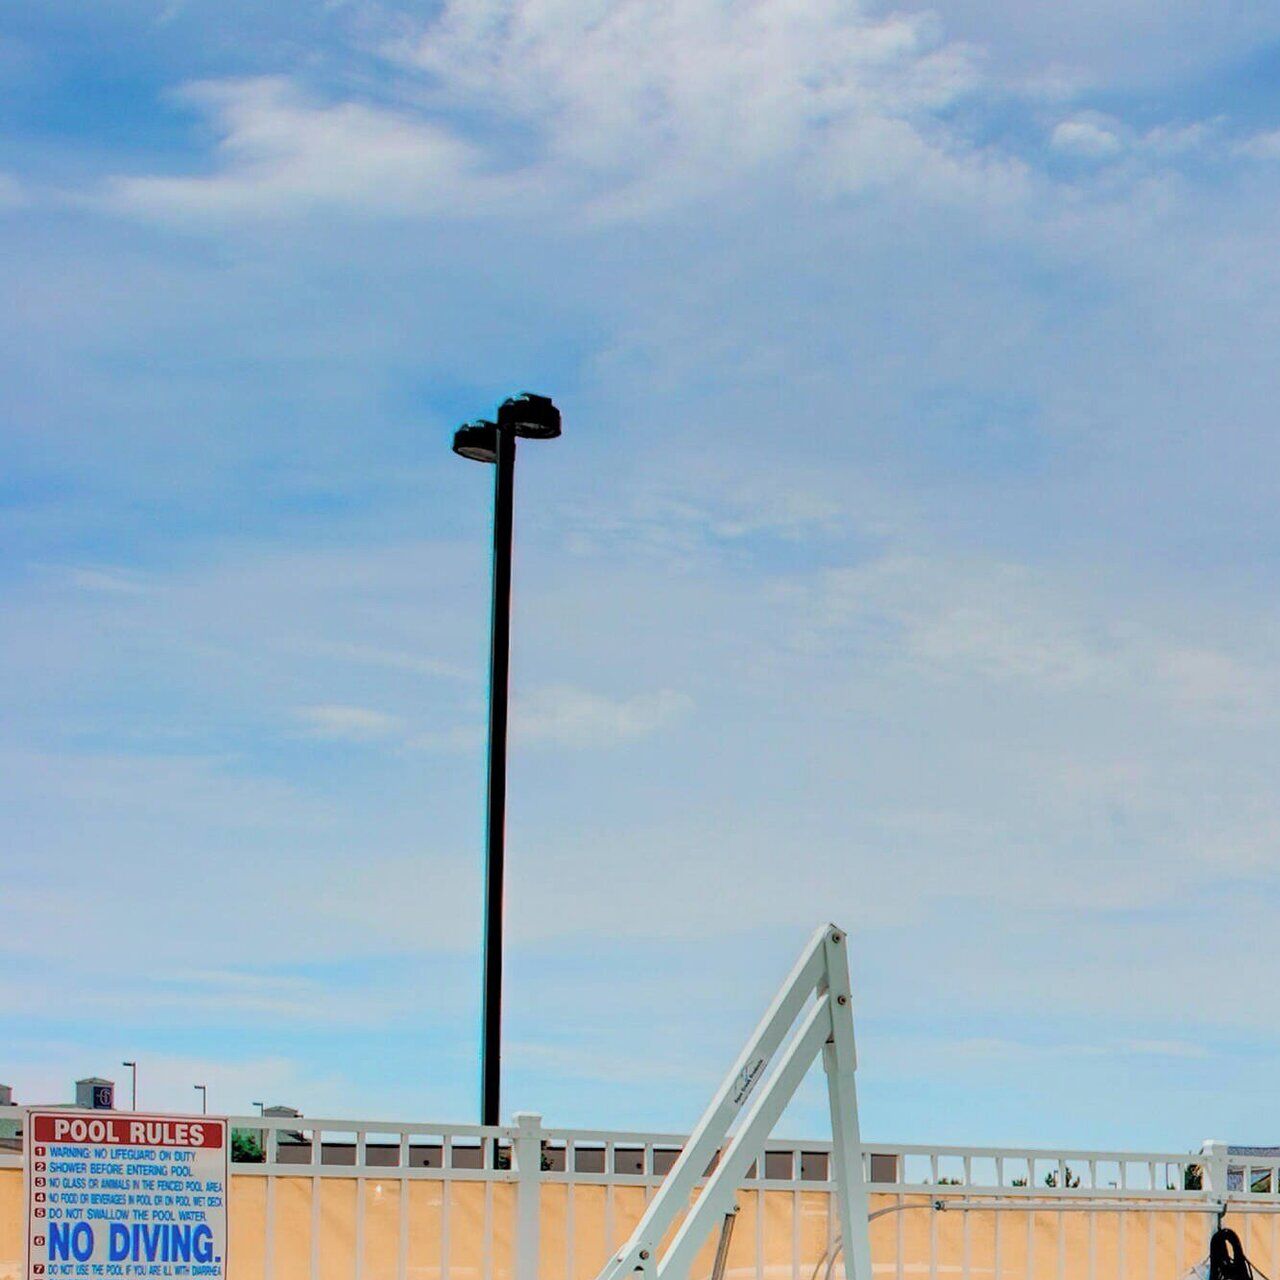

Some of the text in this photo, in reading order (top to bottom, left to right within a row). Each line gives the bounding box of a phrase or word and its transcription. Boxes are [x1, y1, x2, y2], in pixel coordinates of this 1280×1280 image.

[54, 1119, 204, 1146] POOL RULES
[94, 1148, 107, 1158] NO
[110, 1149, 156, 1160] LIFEGUARD
[160, 1150, 171, 1160] ON
[174, 1151, 196, 1161] DUTY
[49, 1162, 87, 1173] SHOWER
[90, 1163, 123, 1174] BEFORE
[127, 1164, 167, 1175] ENTERING
[171, 1166, 193, 1176] POOL
[49, 1177, 60, 1188] NO
[62, 1178, 86, 1188] GLASS
[88, 1179, 98, 1188] OR
[101, 1179, 130, 1190] ANIMALS
[133, 1180, 139, 1189] IN
[142, 1180, 154, 1190] THE
[157, 1180, 183, 1191] FENCED
[186, 1181, 203, 1192] POOL
[206, 1181, 223, 1192] AREA
[49, 1193, 59, 1203] NO
[61, 1193, 78, 1204] FOOD
[80, 1194, 89, 1203] OR
[91, 1194, 126, 1204] BEVERAGES
[136, 1195, 152, 1205] POOL
[193, 1196, 205, 1206] WET
[49, 1208, 62, 1218] DO
[66, 1208, 83, 1218] NOT
[87, 1208, 129, 1219] SWALLOW
[133, 1209, 148, 1219] THE
[152, 1210, 175, 1220] POOL
[179, 1210, 206, 1221] WATER
[48, 1221, 94, 1262] NO
[109, 1222, 222, 1263] DIVING.
[48, 1264, 58, 1275] DO
[60, 1264, 73, 1275] NOT
[76, 1265, 89, 1275] USE
[92, 1265, 103, 1275] THE
[106, 1265, 123, 1275] POOL
[134, 1265, 146, 1275] YOU
[149, 1266, 161, 1275] ARE
